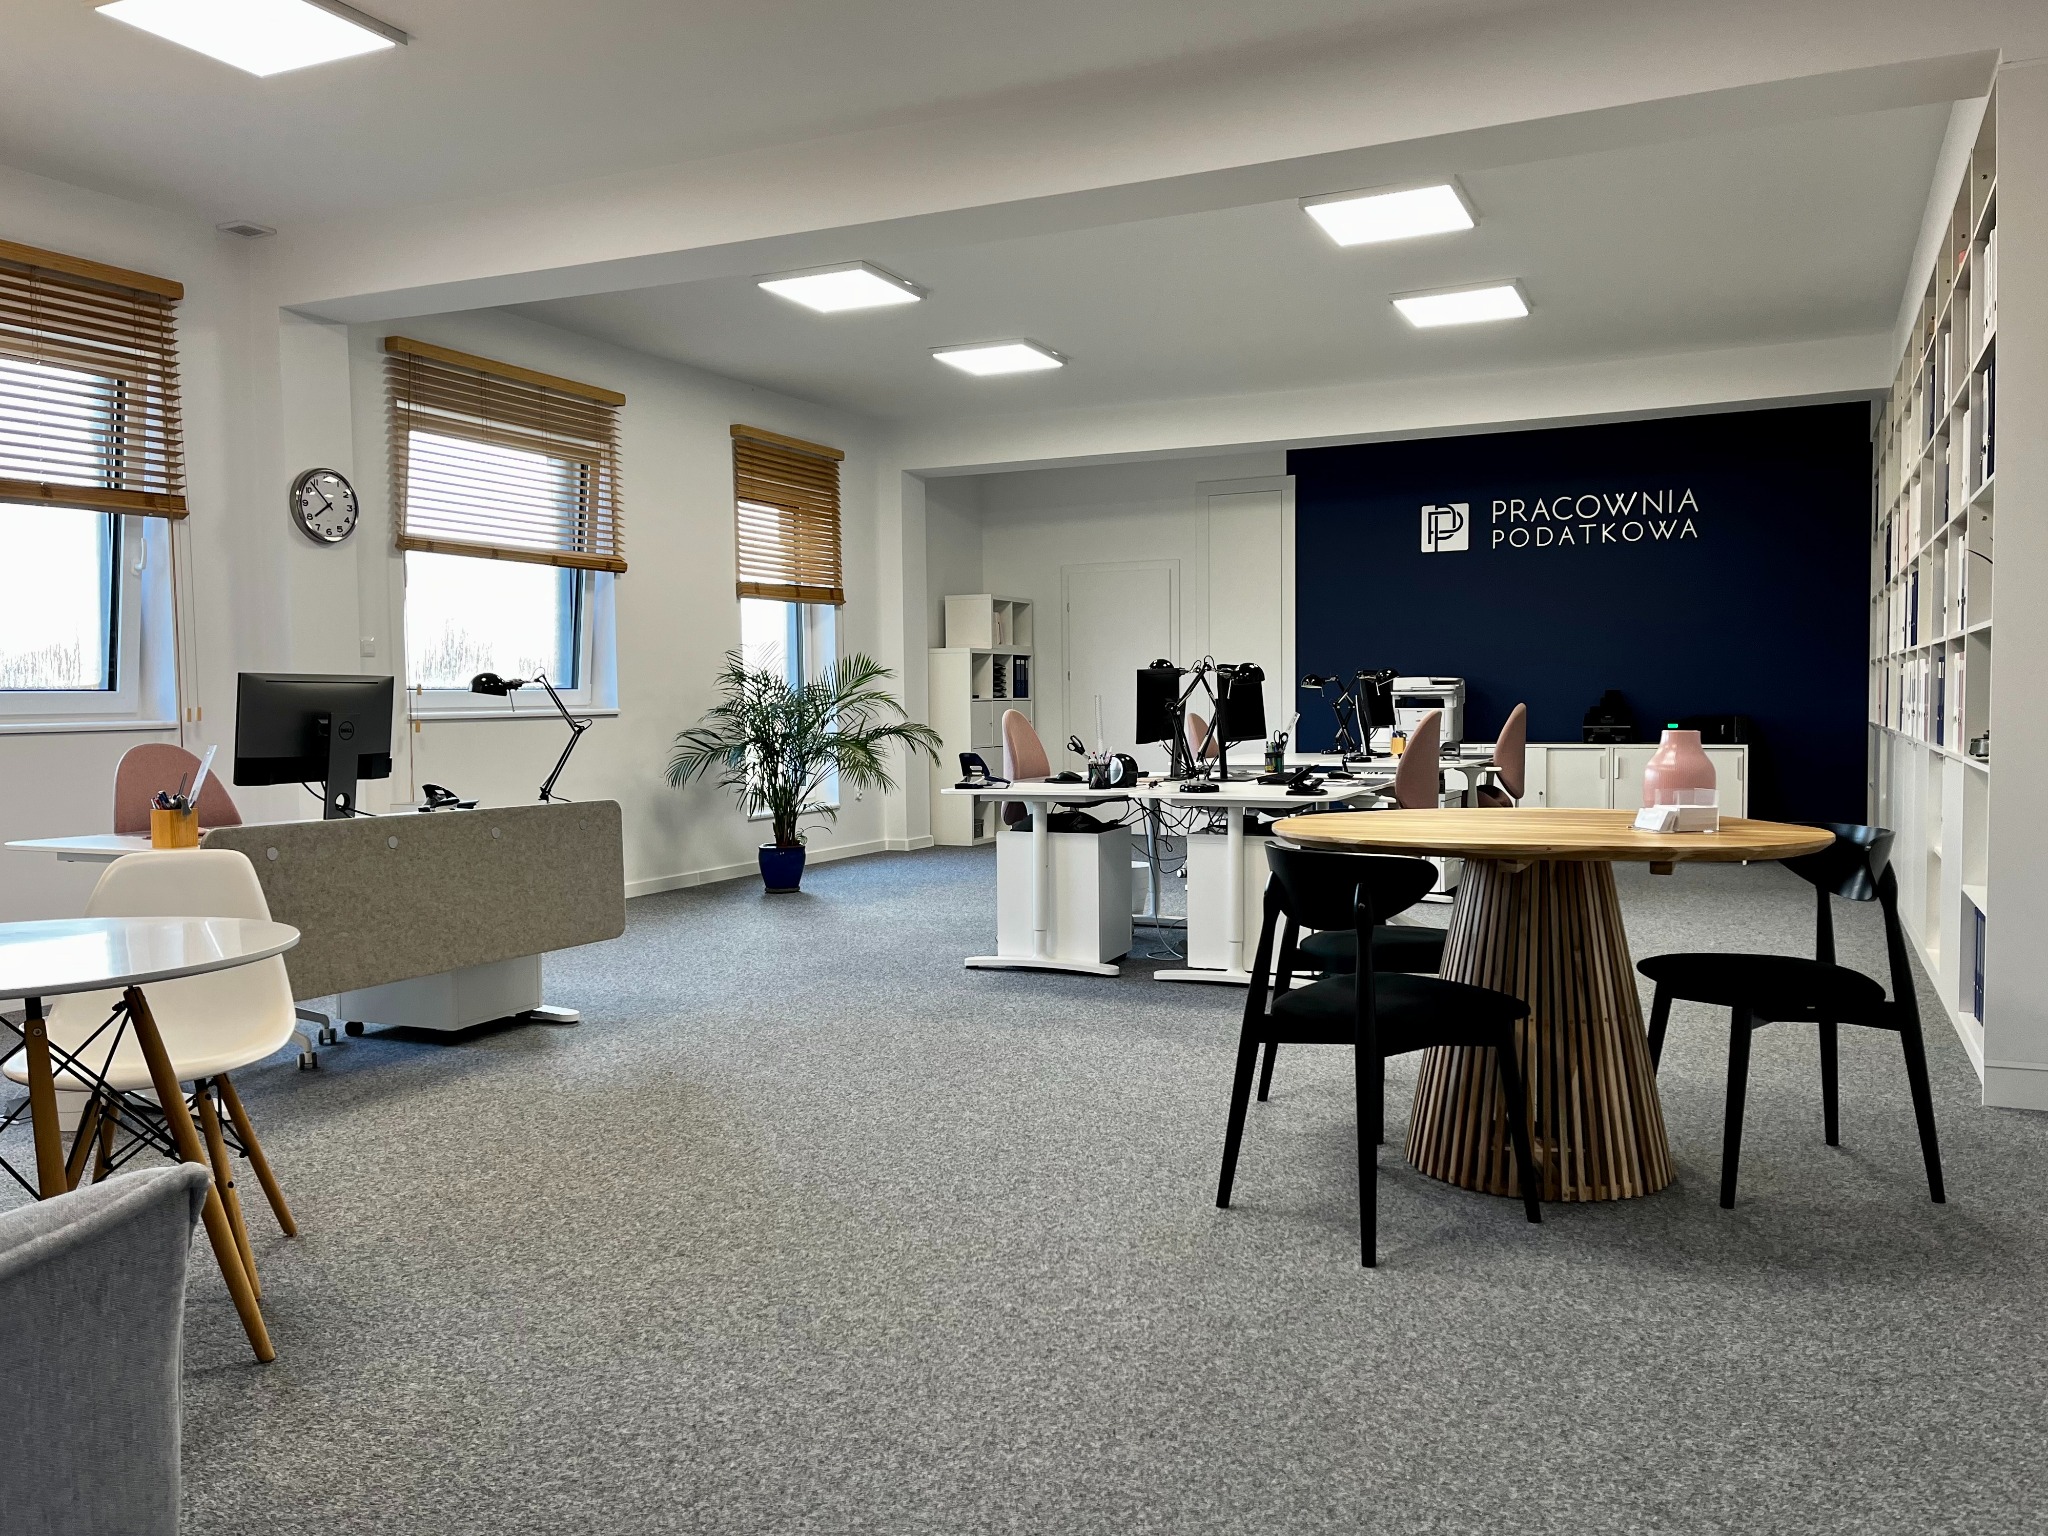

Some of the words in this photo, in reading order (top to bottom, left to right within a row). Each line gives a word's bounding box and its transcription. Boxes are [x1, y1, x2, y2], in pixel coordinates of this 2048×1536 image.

[302, 499, 308, 507] 9
[1492, 488, 1699, 524] PRACOWNIA
[347, 504, 353, 512] 3
[344, 516, 350, 524] 4
[326, 528, 332, 536] 6
[1492, 518, 1699, 550] PODATKOWA
